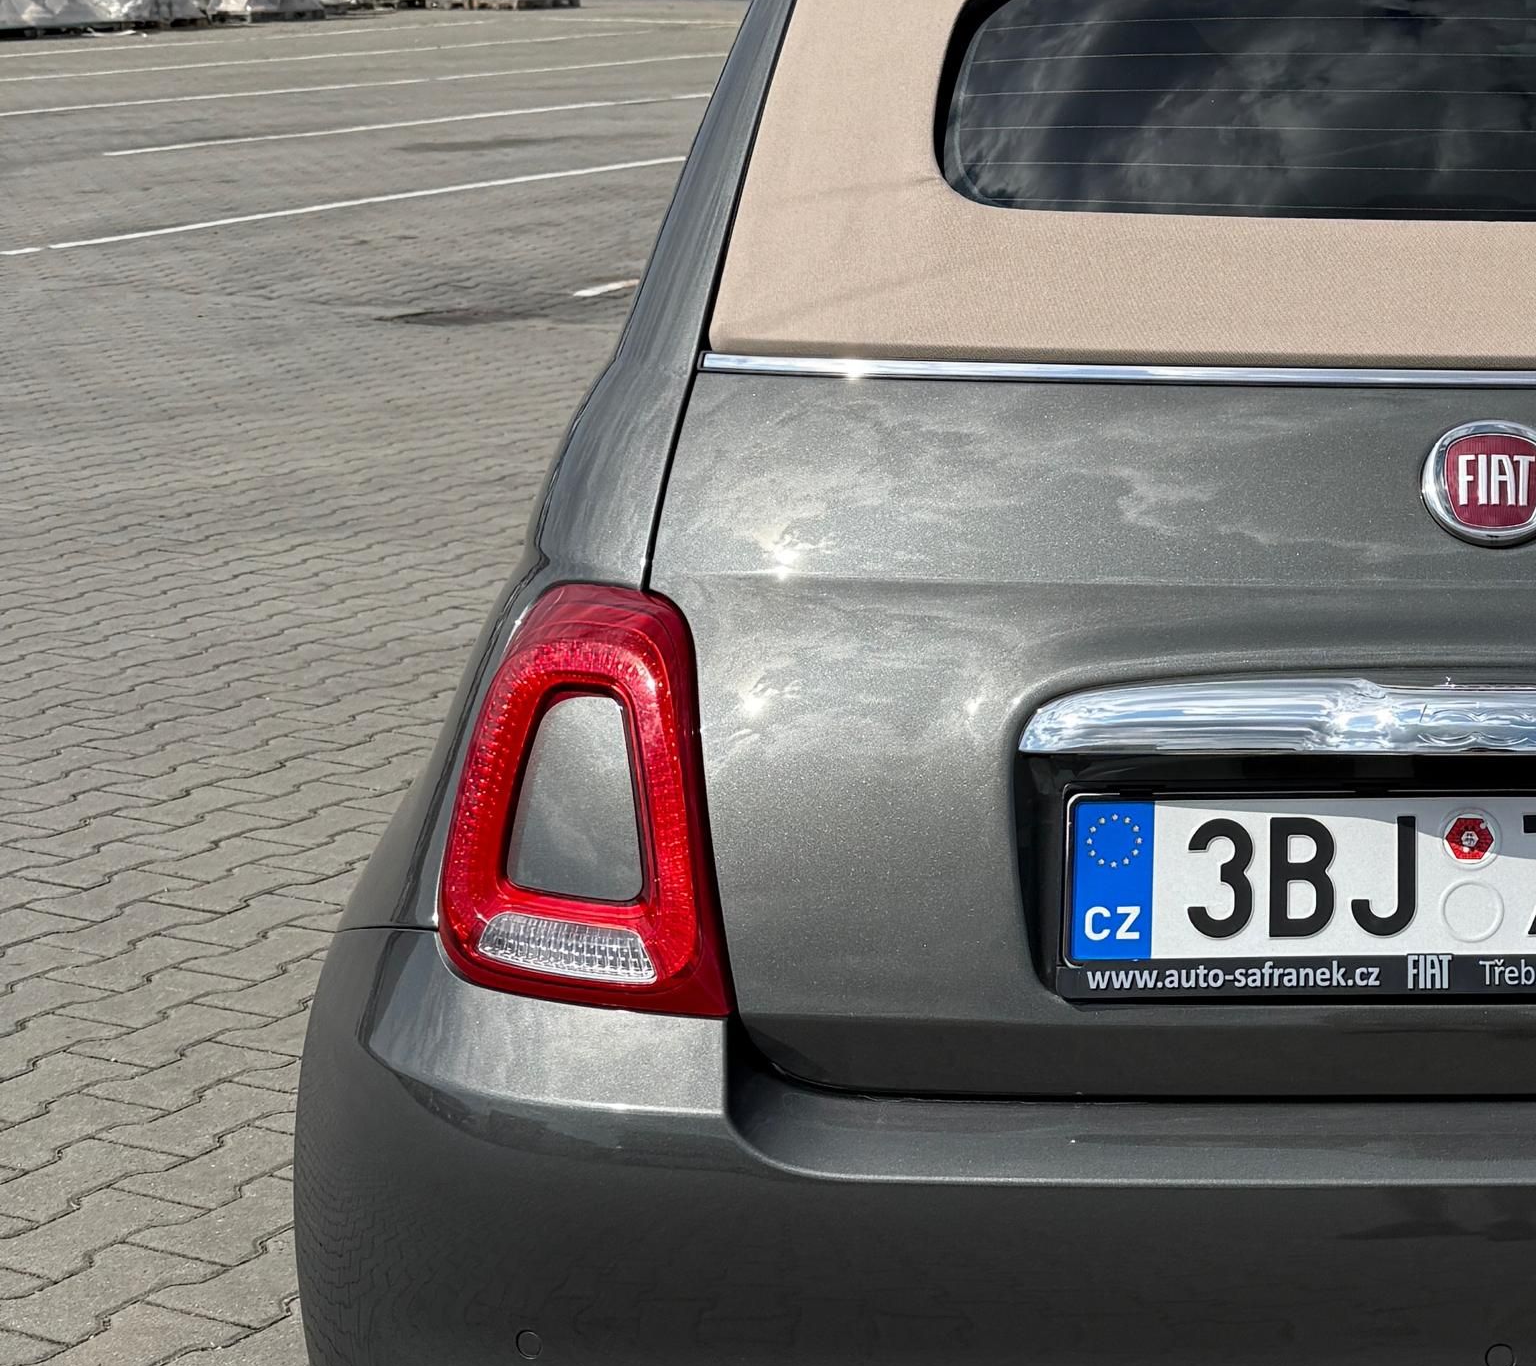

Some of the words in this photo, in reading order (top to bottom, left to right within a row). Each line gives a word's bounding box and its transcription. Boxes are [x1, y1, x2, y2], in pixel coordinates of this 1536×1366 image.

[1458, 454, 1536, 507] FIAT
[1187, 815, 1417, 938] 3BJ
[1084, 906, 1142, 941] CZ
[1087, 960, 1381, 990] www.auto-safranek.cz
[1407, 954, 1453, 990] FIAT
